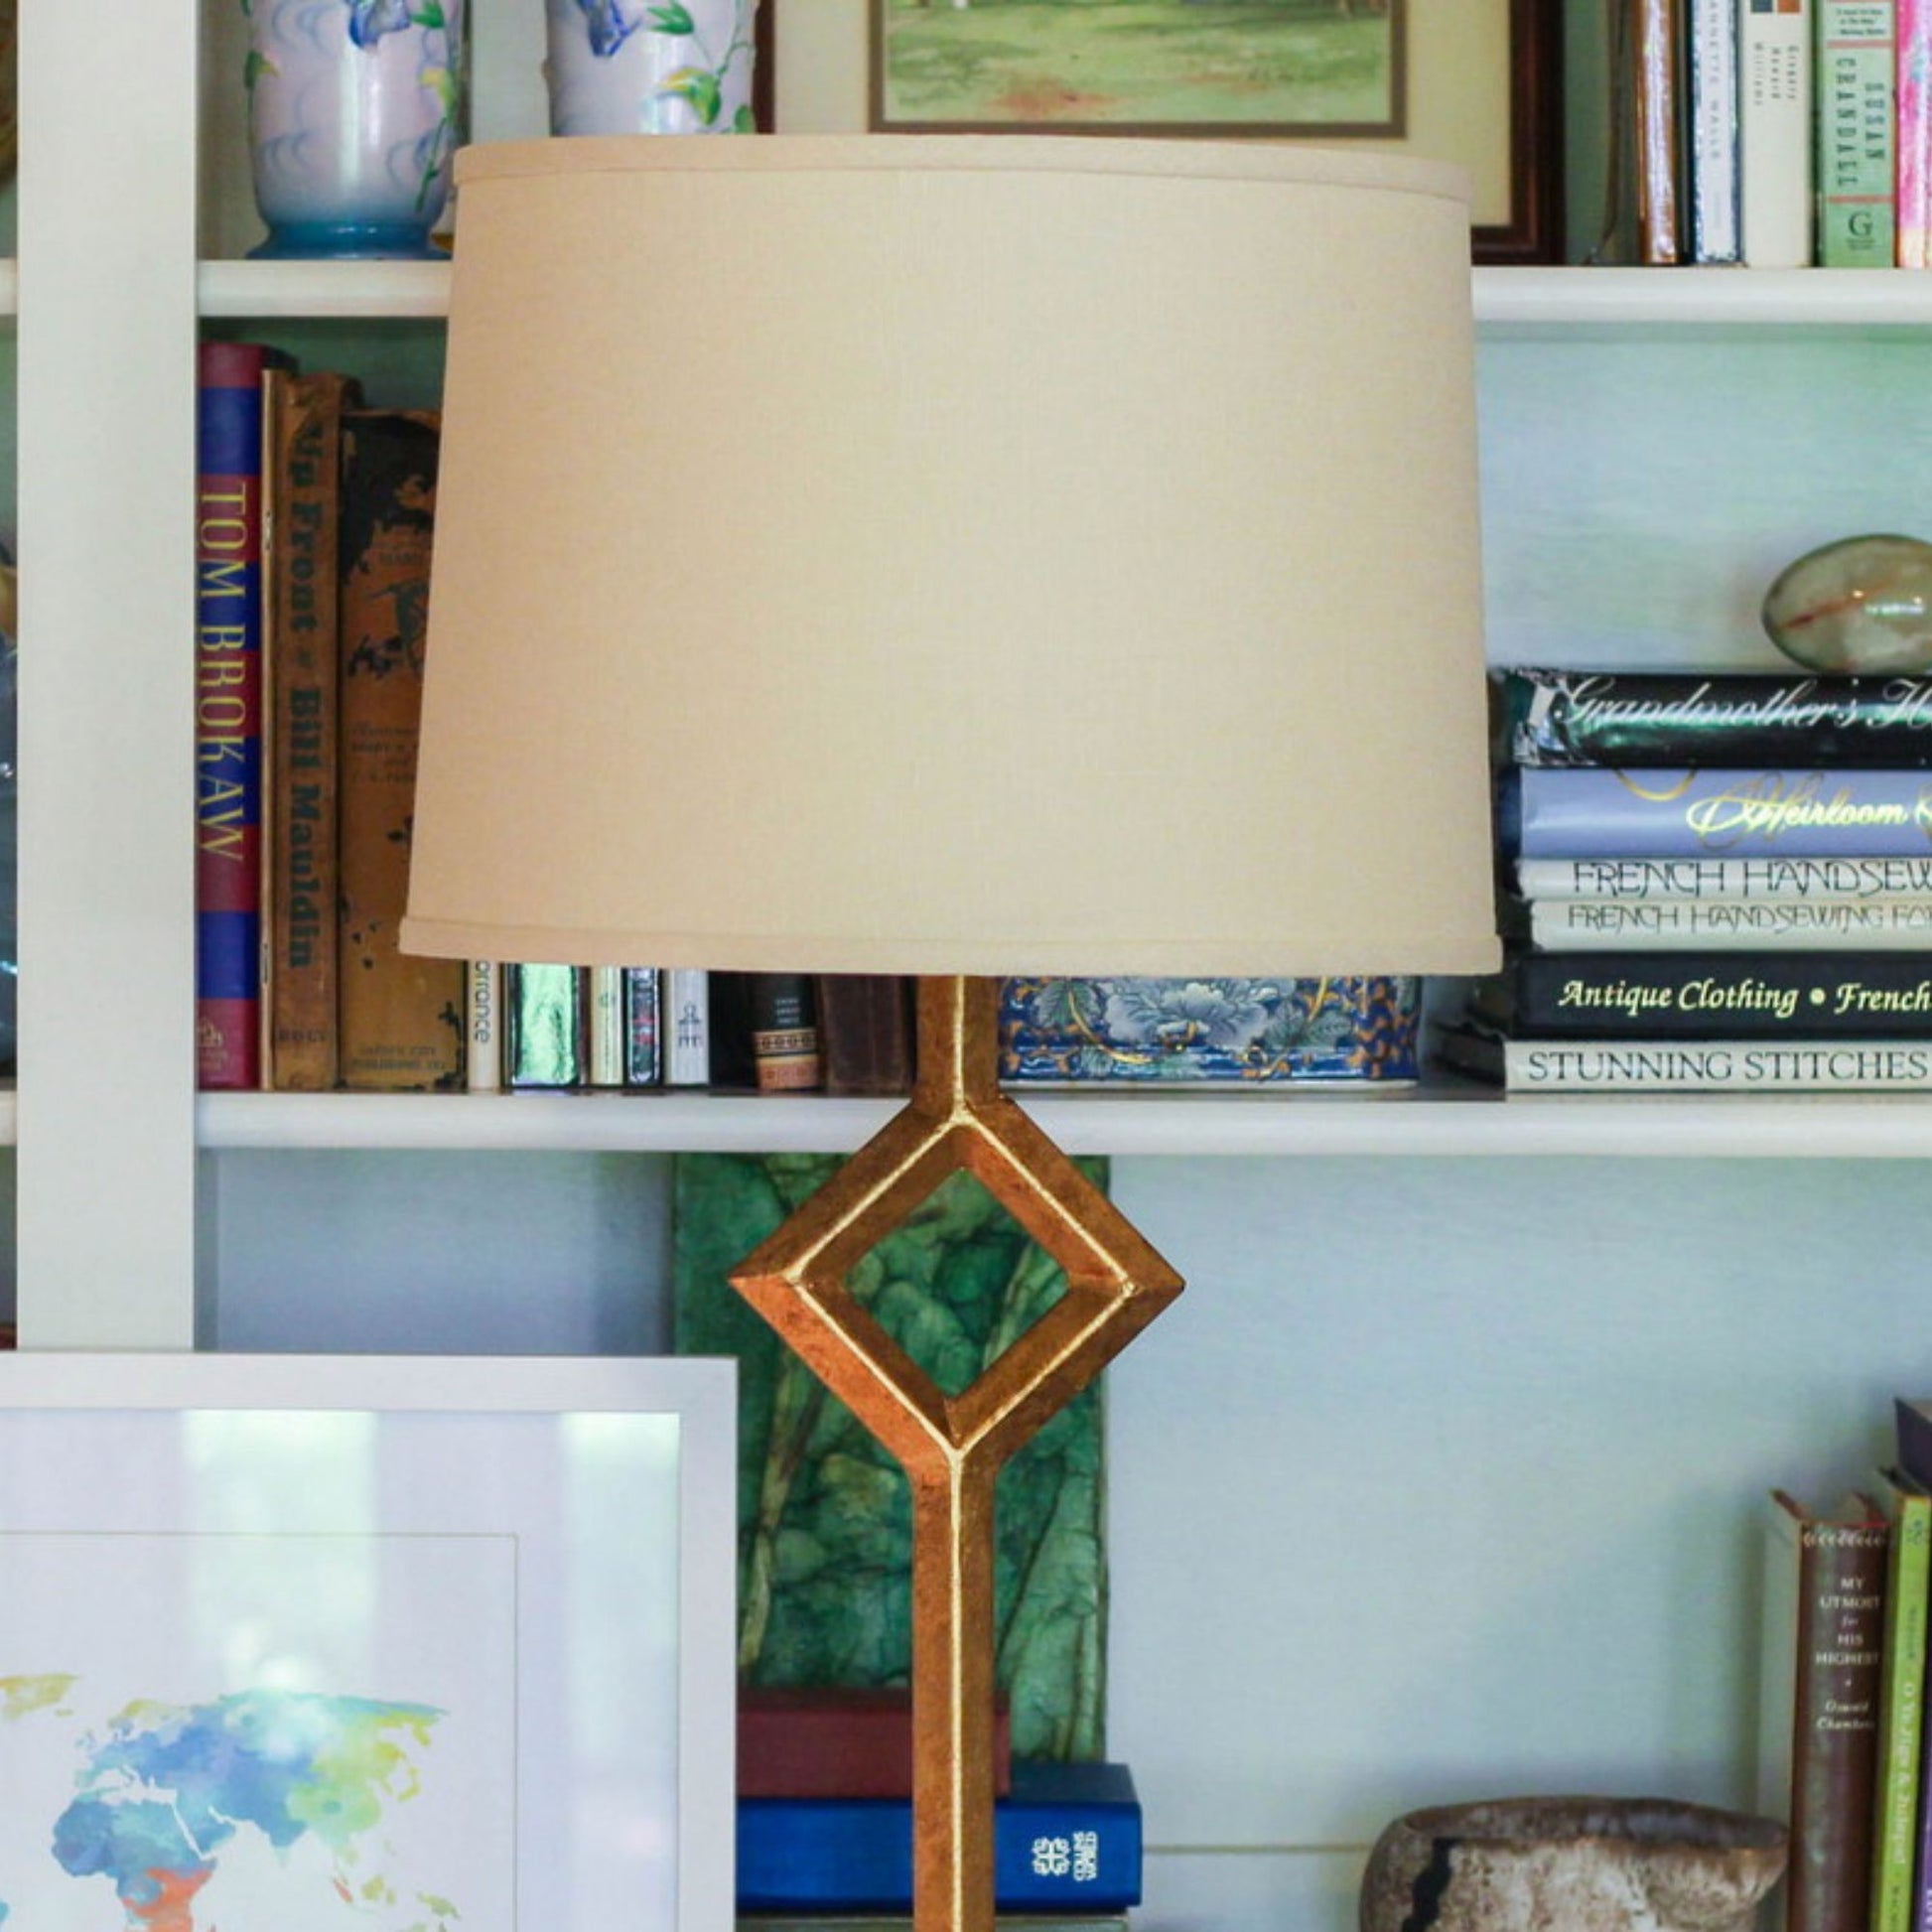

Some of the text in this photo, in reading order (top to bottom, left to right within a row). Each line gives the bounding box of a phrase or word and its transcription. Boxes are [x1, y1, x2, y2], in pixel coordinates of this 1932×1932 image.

[1837, 58, 1859, 187] CRANDALL
[1864, 82, 1885, 160] SUSAN
[1848, 209, 1874, 237] G
[198, 481, 247, 861] TOM BROKAW
[289, 422, 325, 969] Up Front Bill Mauldin
[1555, 676, 1859, 729] Grandmother's
[1686, 772, 1908, 846] Heirloom
[1573, 860, 1725, 897] FRENCH
[1567, 904, 1679, 933] FRENCH
[1691, 903, 1883, 934] HANDSEWING
[1558, 978, 1932, 1019] Antique Clothing French
[1528, 1048, 1929, 1083] STUNNING STITCHES
[1819, 1595, 1880, 1609] UTMOST
[1840, 1577, 1864, 1589] MY
[1838, 1633, 1864, 1645] HIS
